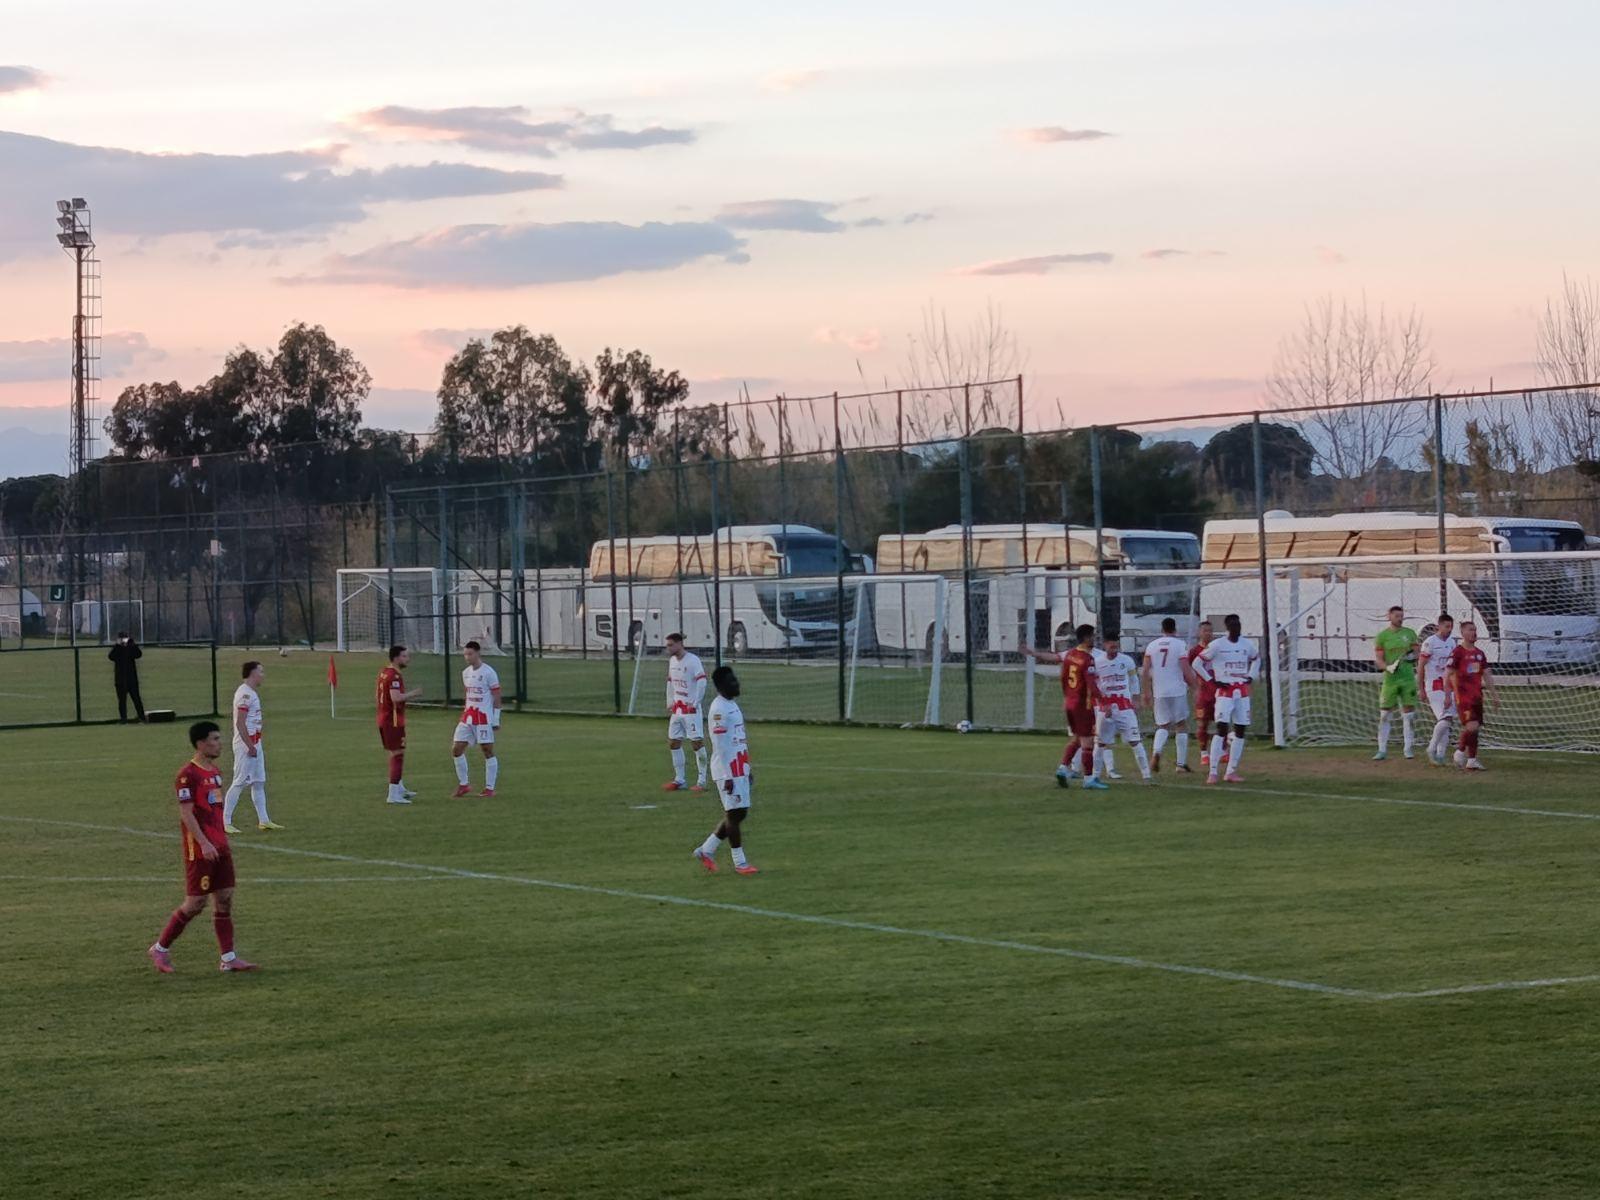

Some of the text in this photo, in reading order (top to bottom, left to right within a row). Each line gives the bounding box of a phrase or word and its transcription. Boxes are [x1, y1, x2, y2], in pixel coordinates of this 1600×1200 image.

[54, 588, 62, 599] J
[1159, 648, 1168, 667] 7
[1068, 664, 1078, 688] 5
[200, 875, 210, 890] 6
